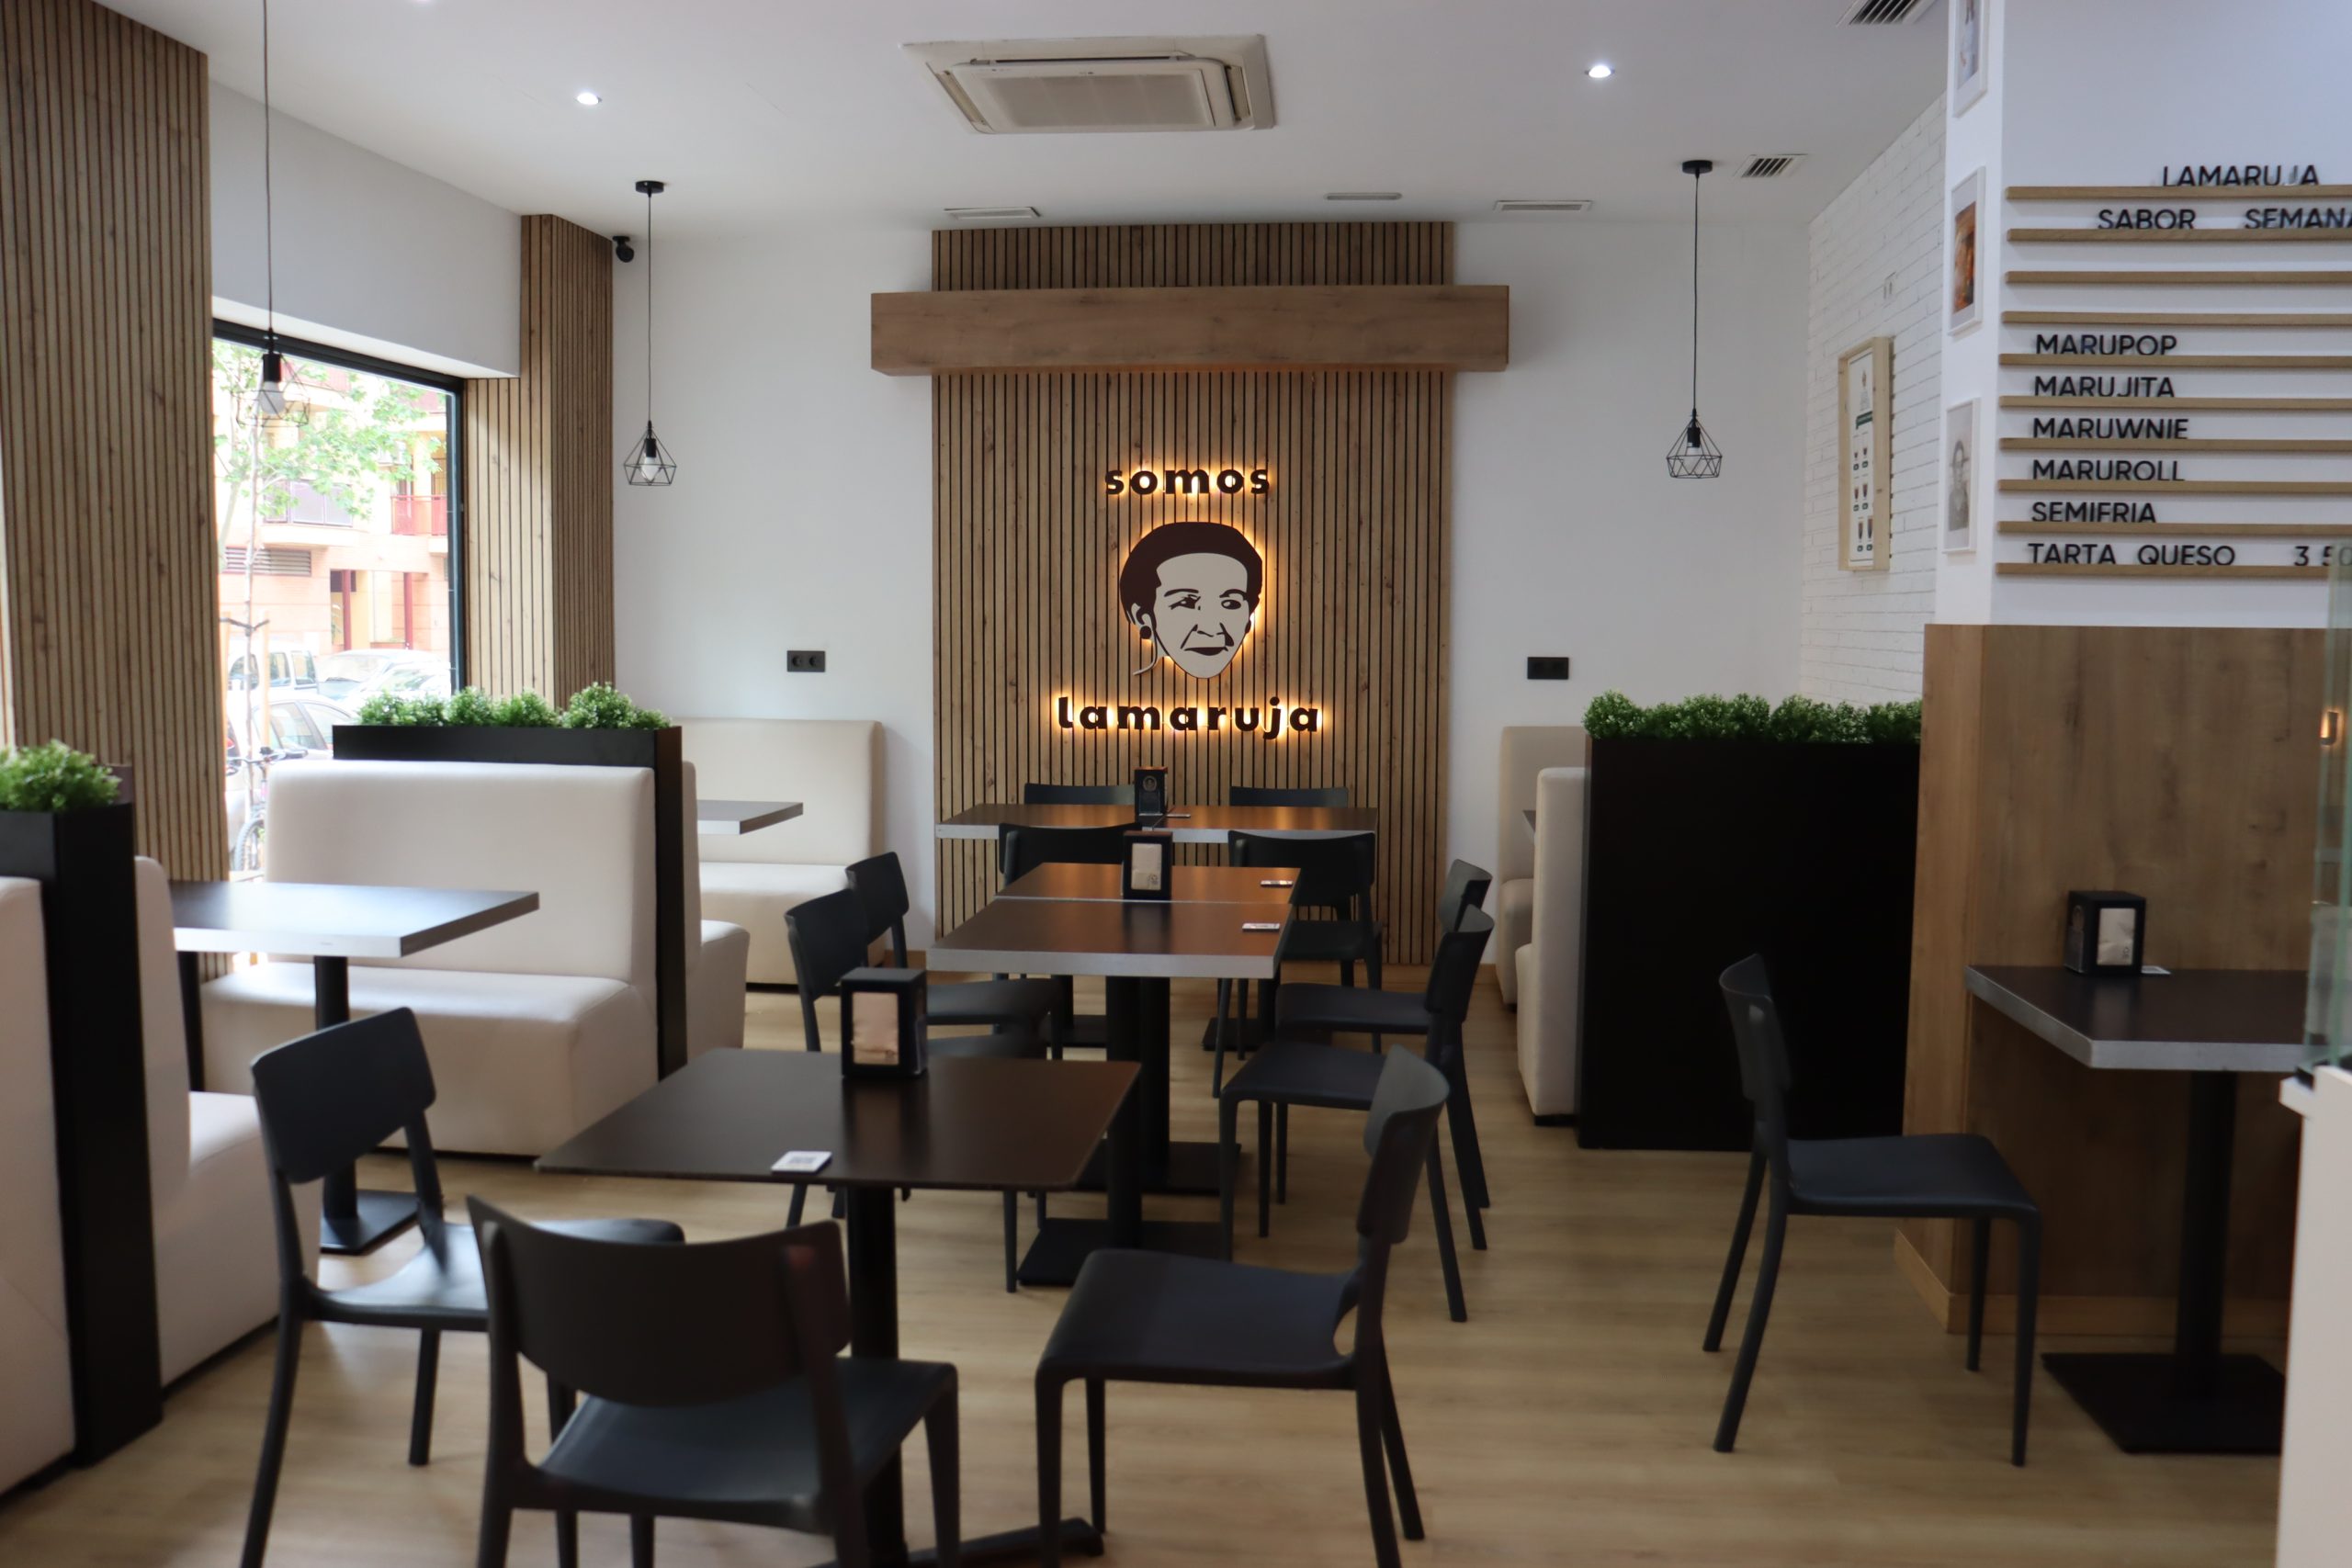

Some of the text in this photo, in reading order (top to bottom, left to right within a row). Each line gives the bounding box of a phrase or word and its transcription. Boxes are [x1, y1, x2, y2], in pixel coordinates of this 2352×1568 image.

[2163, 164, 2319, 186] LAMARUJA
[2098, 209, 2197, 230] SABOR
[2035, 334, 2177, 356] MARUPOP
[2034, 376, 2176, 398] MARUJITA
[2032, 418, 2188, 439] MARUWNIE
[2031, 459, 2185, 481] MARUROLL
[1104, 468, 1270, 495] somos
[2031, 502, 2157, 524] SEMIFRIA
[2028, 543, 2117, 565] TARTA
[2137, 545, 2235, 566] QUESO
[1057, 696, 1318, 740] lamaruja
